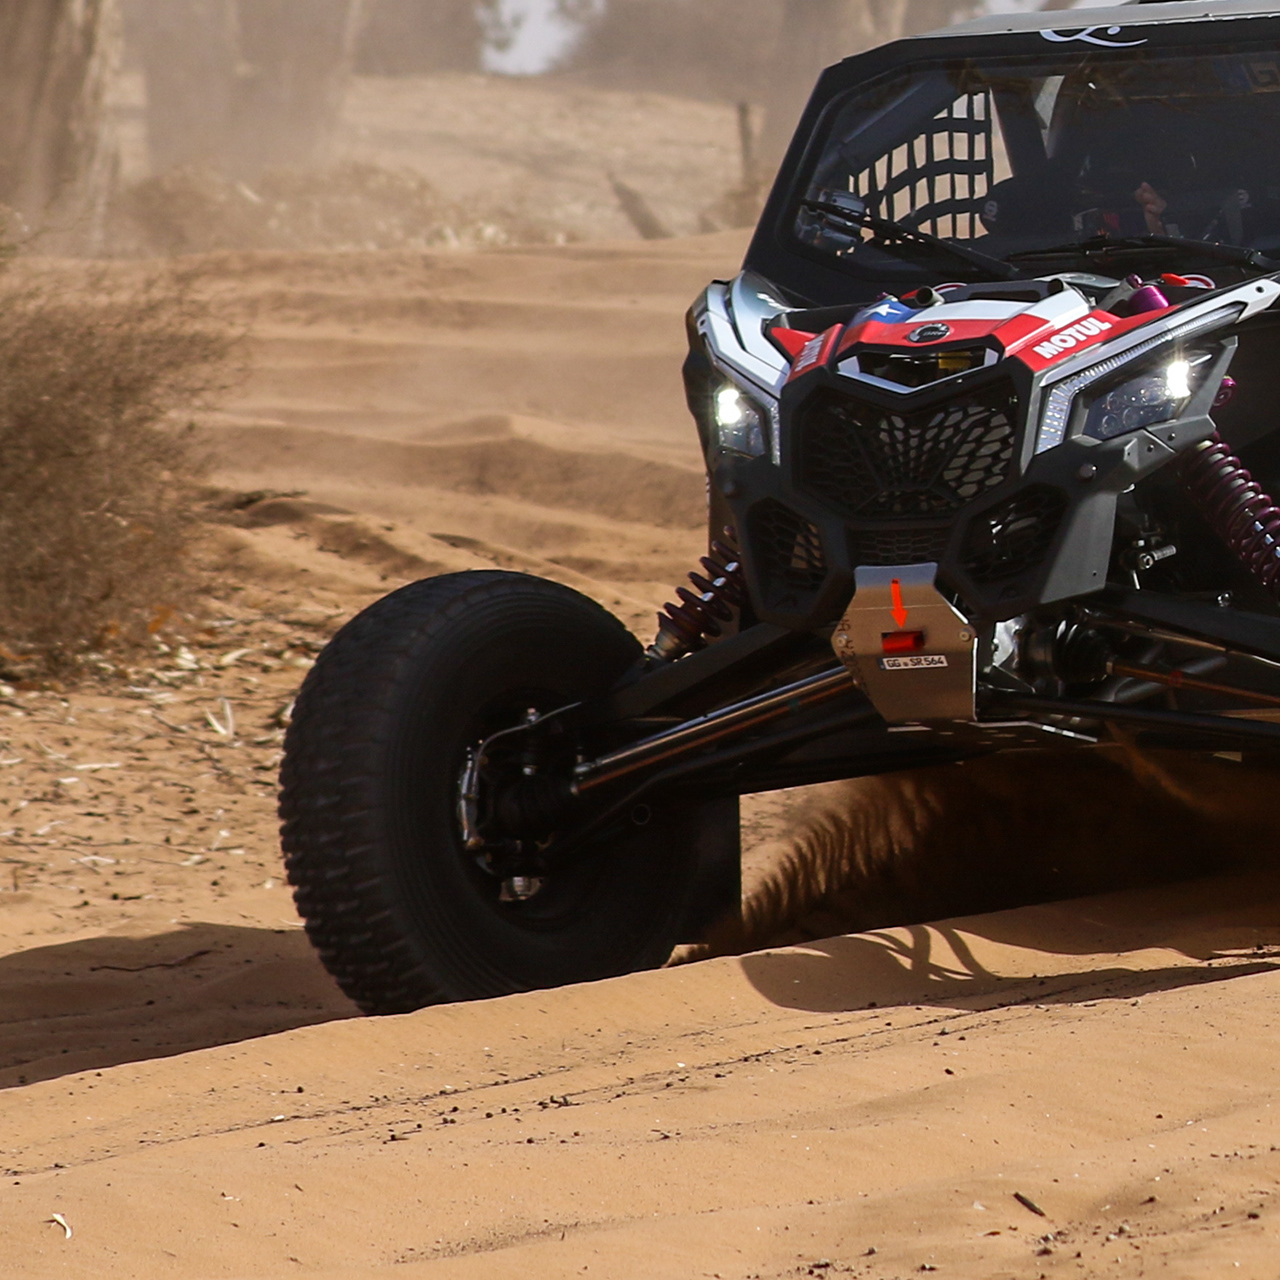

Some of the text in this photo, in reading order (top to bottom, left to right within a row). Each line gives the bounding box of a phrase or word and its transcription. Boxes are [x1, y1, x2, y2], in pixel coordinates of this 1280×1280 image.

[1032, 316, 1114, 360] MOTUL
[886, 656, 945, 668] GG SR 564
